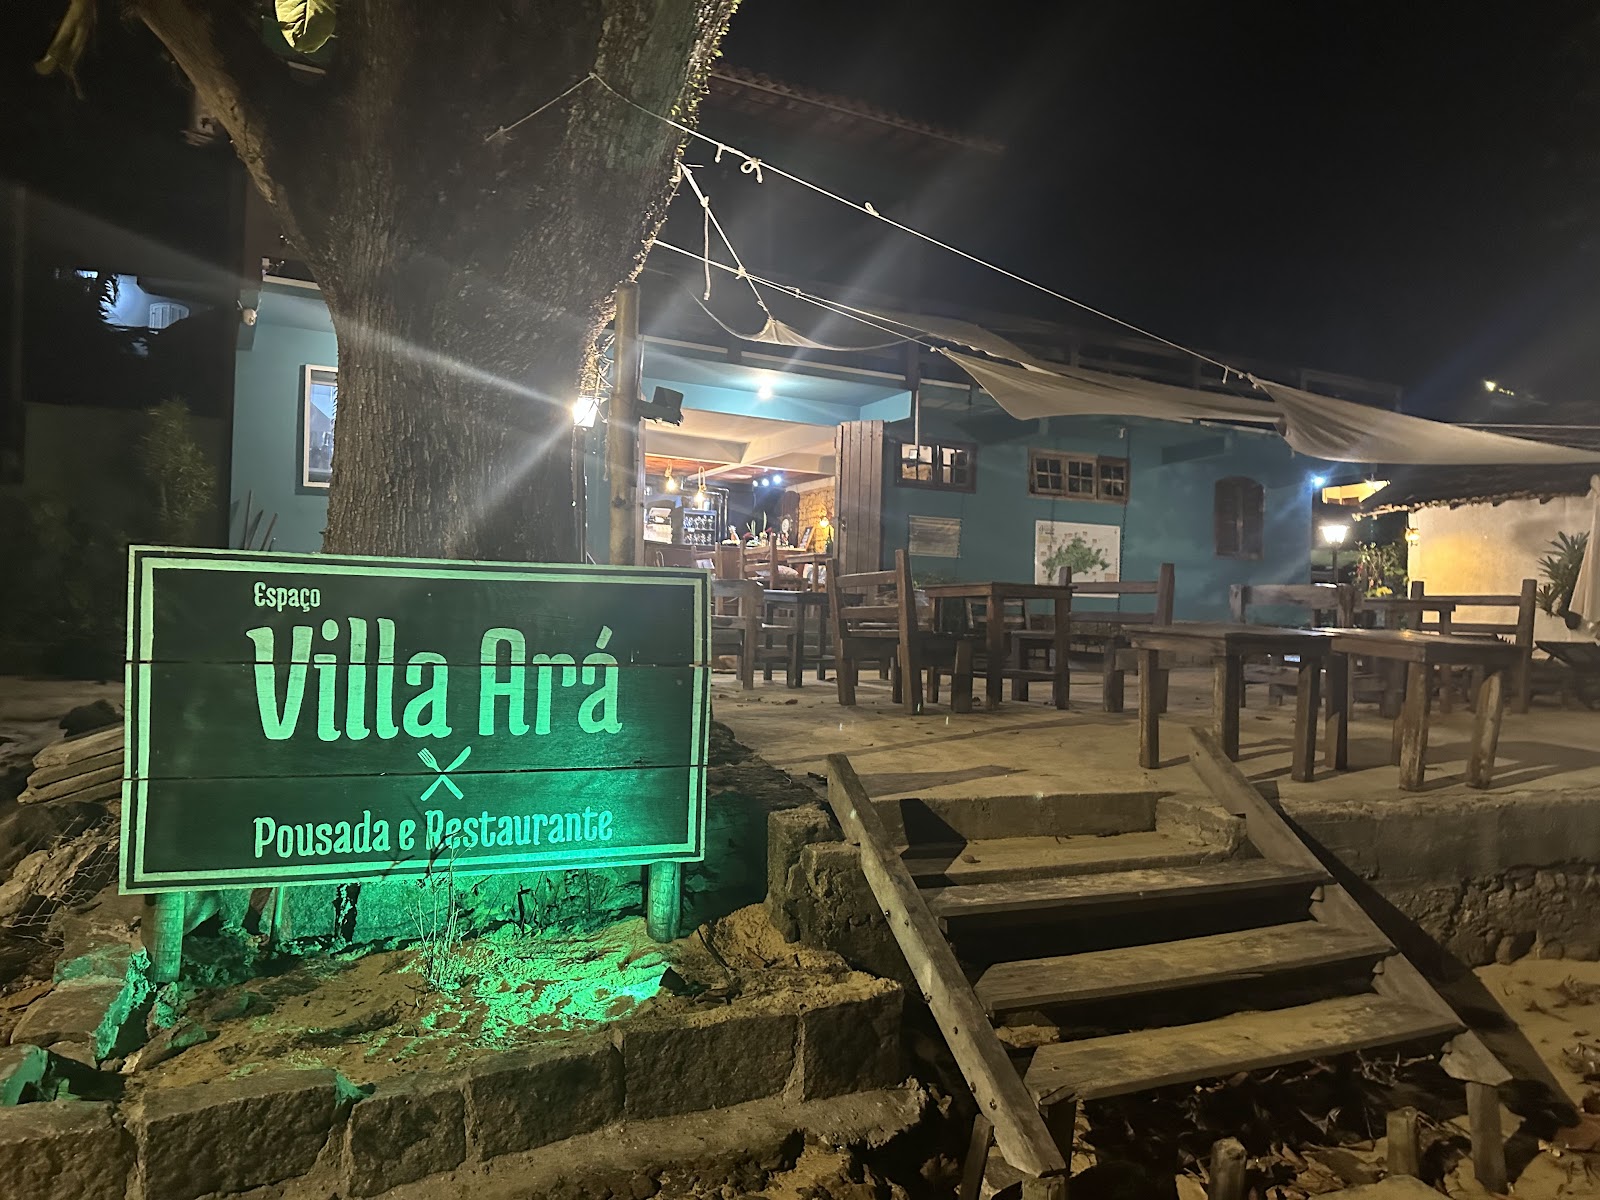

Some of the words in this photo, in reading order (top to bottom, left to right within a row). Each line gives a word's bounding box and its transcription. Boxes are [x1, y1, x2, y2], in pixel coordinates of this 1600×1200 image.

[254, 582, 320, 612] Espaço
[246, 617, 452, 741] Villa
[478, 625, 623, 737] Ará
[253, 811, 390, 858] Pousada
[399, 822, 415, 849] e
[425, 808, 613, 850] Restaurante
